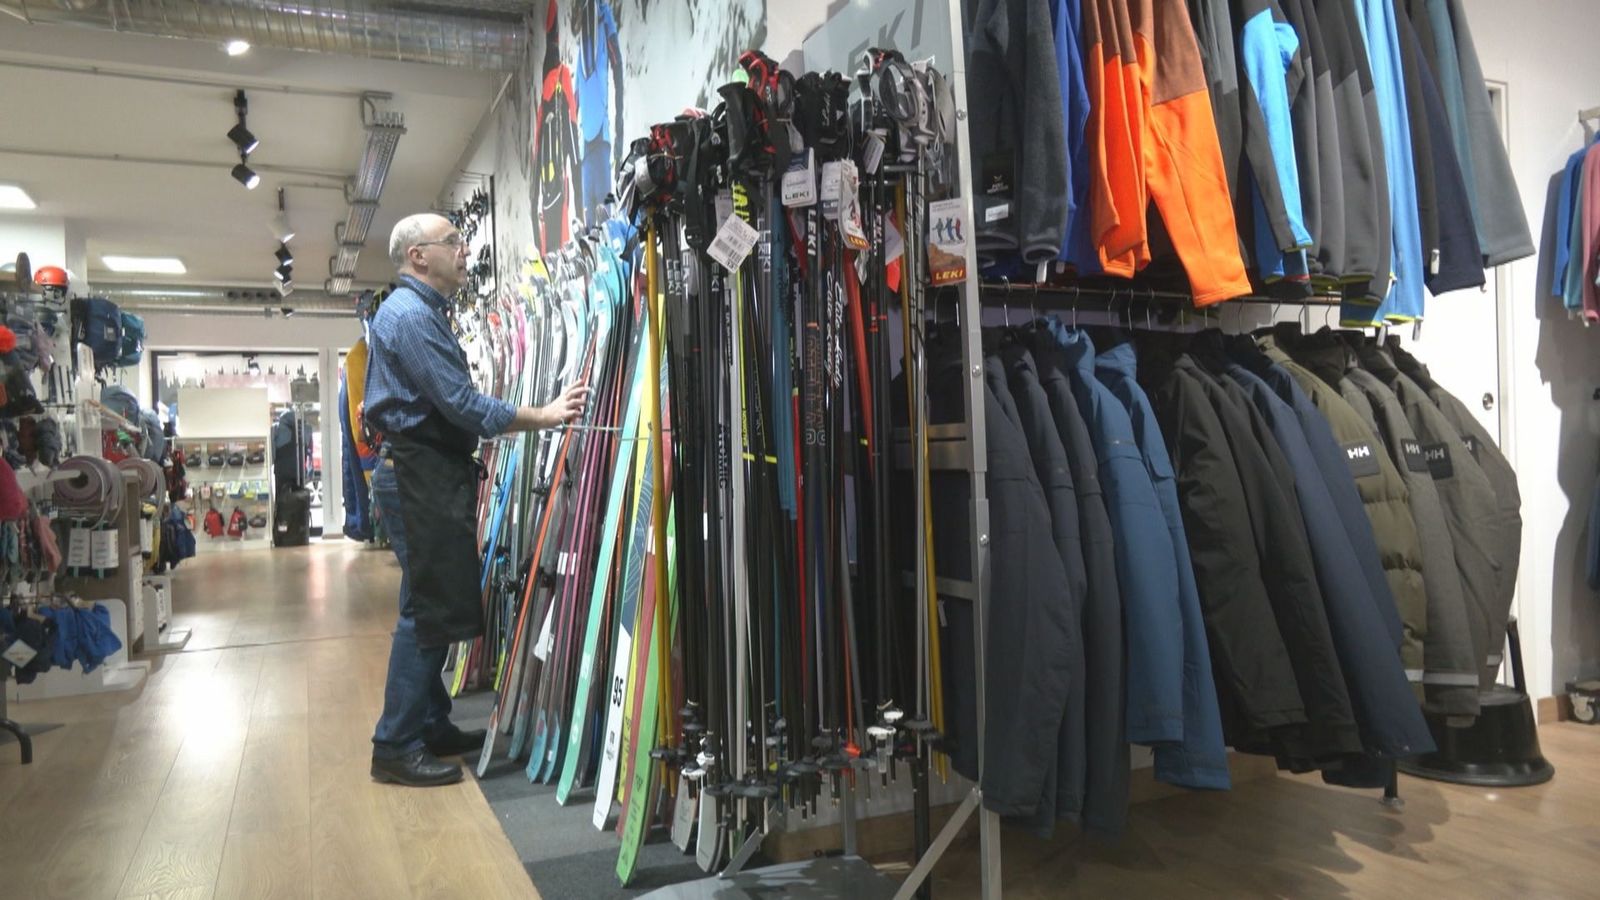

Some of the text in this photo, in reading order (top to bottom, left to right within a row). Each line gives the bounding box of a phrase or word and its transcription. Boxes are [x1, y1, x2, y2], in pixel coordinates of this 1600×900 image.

[784, 191, 810, 200] LEKI
[808, 209, 816, 256] LEKI
[763, 230, 771, 273] LEKI
[666, 259, 674, 295] LEKI
[673, 260, 682, 296] LEKI
[935, 269, 963, 281] LEKI
[1347, 445, 1370, 459] HH
[1405, 443, 1420, 454] HH
[1425, 448, 1445, 460] HH
[613, 676, 623, 708] 95
